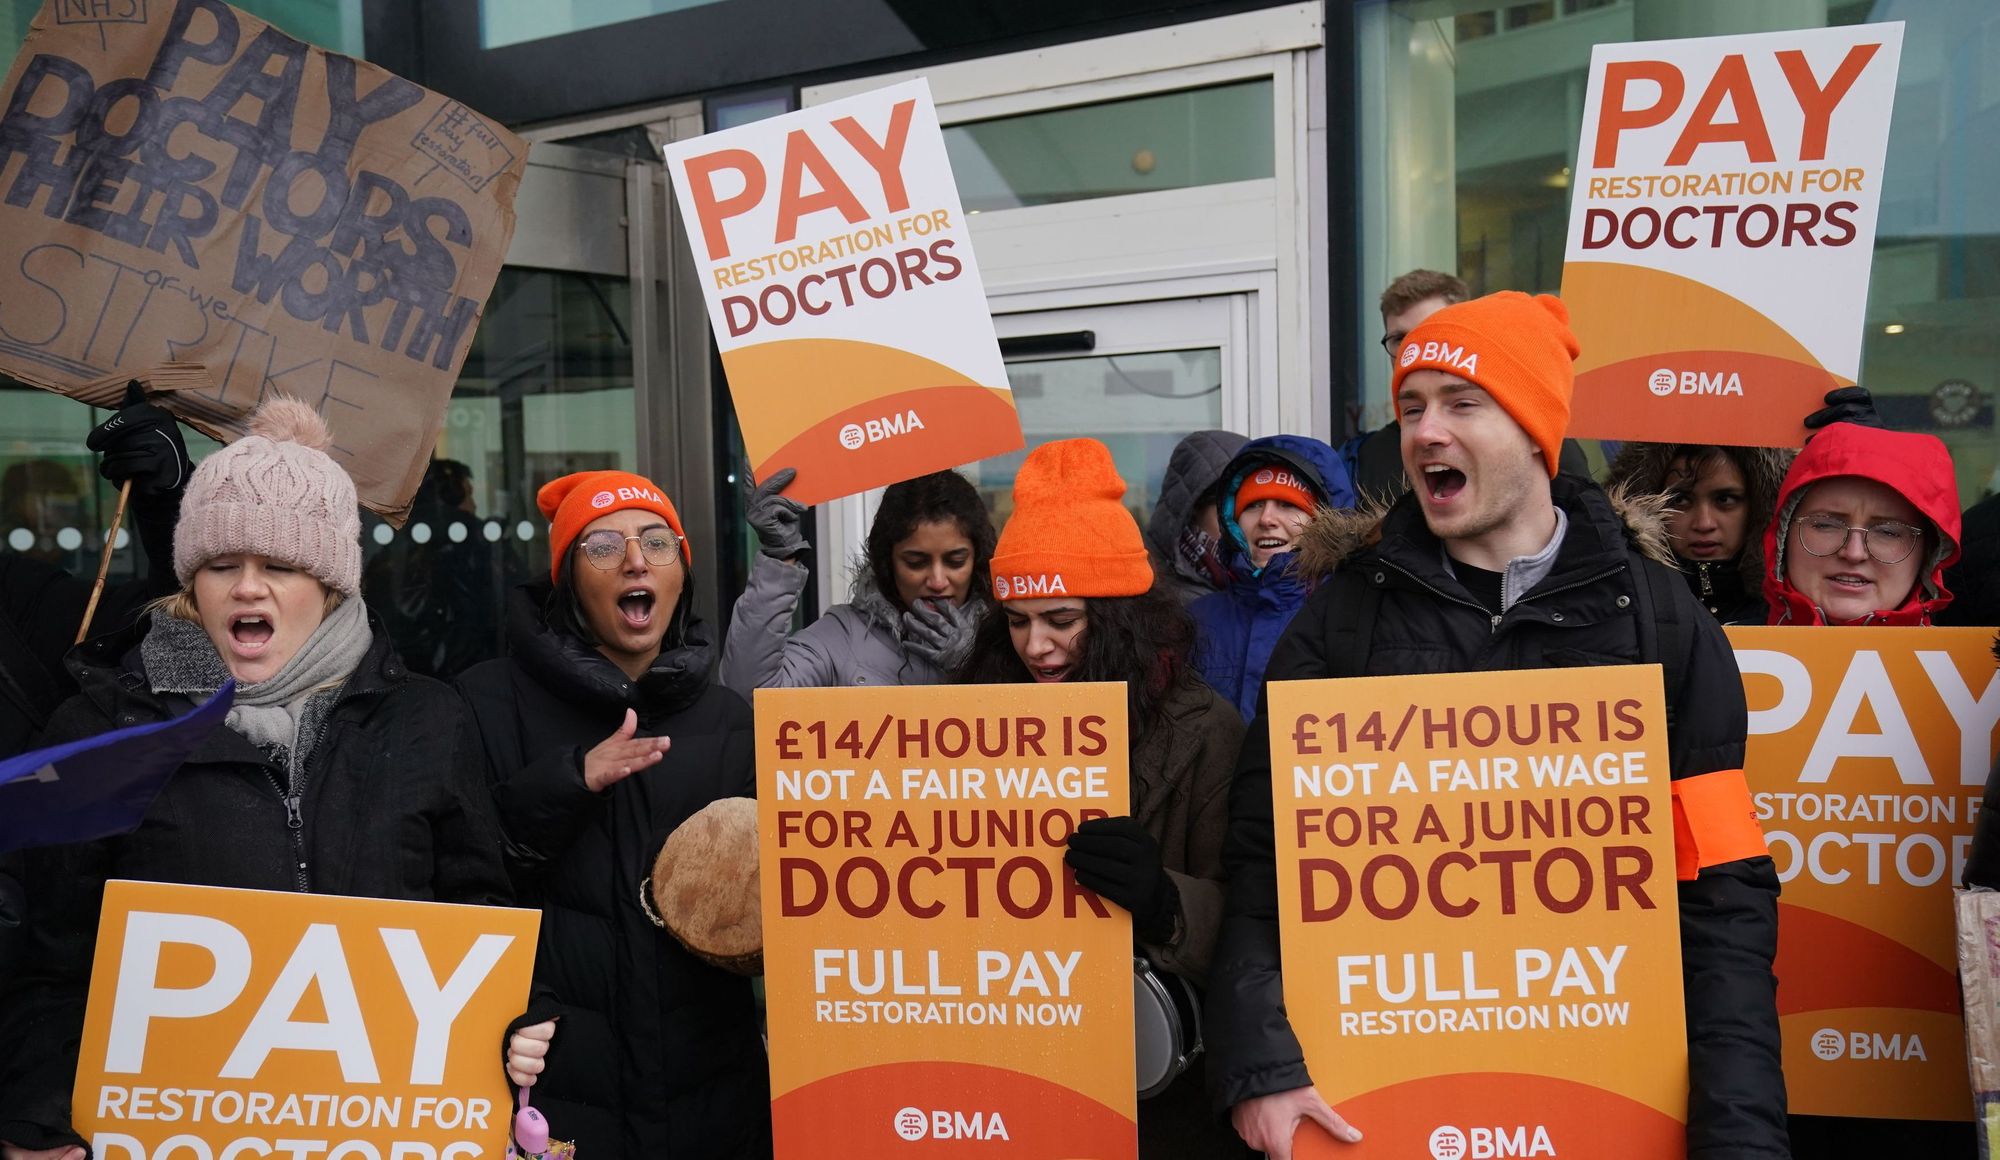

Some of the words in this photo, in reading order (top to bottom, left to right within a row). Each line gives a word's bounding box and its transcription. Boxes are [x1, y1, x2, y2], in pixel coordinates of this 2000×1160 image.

[64, 0, 138, 18] NHS
[146, 0, 425, 166] PAY
[1593, 43, 1882, 169] PAY
[418, 132, 485, 185] restoration
[434, 123, 465, 152] pay
[0, 54, 473, 290] DOCTORS
[683, 98, 917, 262] PAY
[1588, 171, 1792, 199] RESTORATION
[1800, 168, 1865, 194] FOR
[713, 224, 893, 289] RESTORATION
[897, 209, 951, 241] FOR
[1582, 201, 1859, 250] DOCTORS
[144, 269, 184, 290] or
[189, 285, 231, 320] we
[232, 214, 480, 371] WORTH
[721, 239, 962, 338] DOCTORS
[1422, 342, 1479, 375] BMA
[1679, 372, 1744, 397] BMA
[865, 410, 925, 443] BMA
[617, 487, 663, 504] BMA
[1013, 574, 1067, 595] BMA
[775, 714, 1047, 760] £14/HOUR
[1063, 715, 1108, 756] IS
[1292, 703, 1582, 754] £14/HOUR
[1597, 698, 1645, 742] IS
[776, 770, 855, 801] NOT
[864, 769, 891, 800] A
[902, 768, 986, 800] FAIR
[994, 766, 1109, 798] WAGE
[1293, 762, 1379, 798] NOT
[1389, 760, 1419, 794] A
[1429, 756, 1520, 792] FAIR
[1528, 751, 1649, 789] WAGE
[778, 810, 873, 848] FOR
[885, 810, 919, 848] A
[1296, 804, 1400, 848] FOR
[1412, 803, 1450, 844] A
[1459, 795, 1652, 849] JUNIOR
[1750, 792, 1956, 824] STORATION
[1763, 830, 1974, 887] OCTO
[779, 856, 1112, 919] DOCTOR
[1299, 845, 1657, 923] DOCTOR
[813, 949, 961, 996] FULL
[977, 950, 1082, 997] PAY
[1337, 950, 1499, 1005] FULL
[1515, 945, 1628, 998] PAY
[104, 911, 516, 1085] PAY
[816, 1001, 1007, 1026] RESTORATION
[1016, 1003, 1082, 1026] NOW
[1340, 1005, 1550, 1036] RESTORATION
[1558, 1002, 1630, 1028] NOW
[1850, 1033, 1927, 1062] BMA
[97, 1085, 401, 1129] RESTORATION
[410, 1097, 492, 1130] FOR
[932, 1111, 1009, 1141] BMA
[1470, 1124, 1556, 1160] BMA
